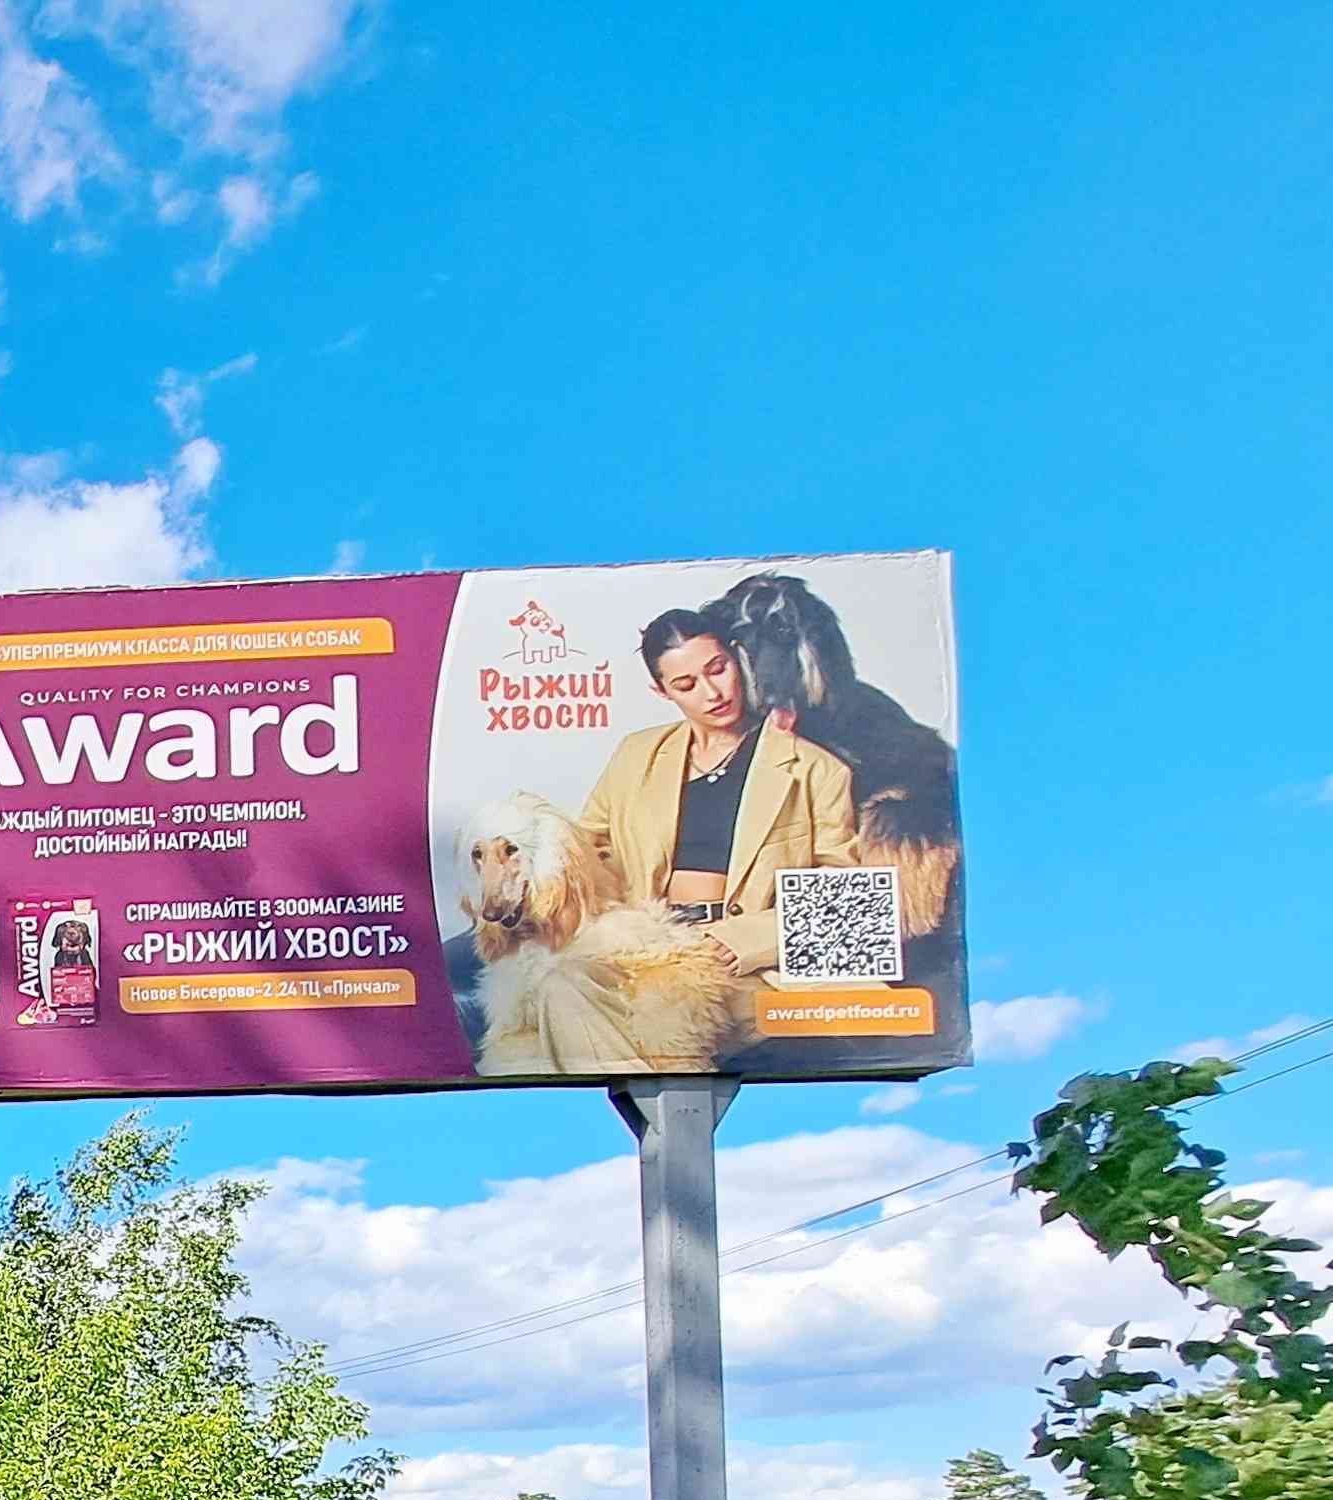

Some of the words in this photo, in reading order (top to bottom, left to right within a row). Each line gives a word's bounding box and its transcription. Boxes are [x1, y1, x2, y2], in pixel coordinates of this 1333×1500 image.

[124, 637, 190, 656] КЛАССА
[192, 634, 228, 655] ДЛЯ
[230, 632, 288, 652] КОШЕК
[290, 631, 303, 648] И
[305, 628, 361, 648] СОБАК
[20, 687, 114, 707] QUALITY
[123, 685, 166, 700] FOR
[176, 679, 312, 698] CHAMPIONS
[479, 660, 612, 701] Рыжий
[66, 804, 156, 829] ПИТОМЕЦ
[171, 803, 208, 824] ЭТО
[209, 799, 307, 824] ЧЕМПИОН,
[34, 832, 151, 858] ДОСТОЙНЫЙ
[153, 829, 248, 851] НАГРАДЫ!
[126, 897, 257, 922] СПРАШИВАЙТЕ
[259, 900, 273, 917] В
[274, 895, 405, 917] ЗООМАГАЗИНЕ
[13, 915, 41, 997] Award
[123, 921, 277, 964] «РЫЖИЙ
[284, 924, 409, 960] ХВОСТ»
[130, 986, 177, 1002] Новое
[300, 980, 322, 999] ТЦ
[323, 978, 401, 998] «Причал»
[765, 1003, 921, 1022] awardpetfood.ru
